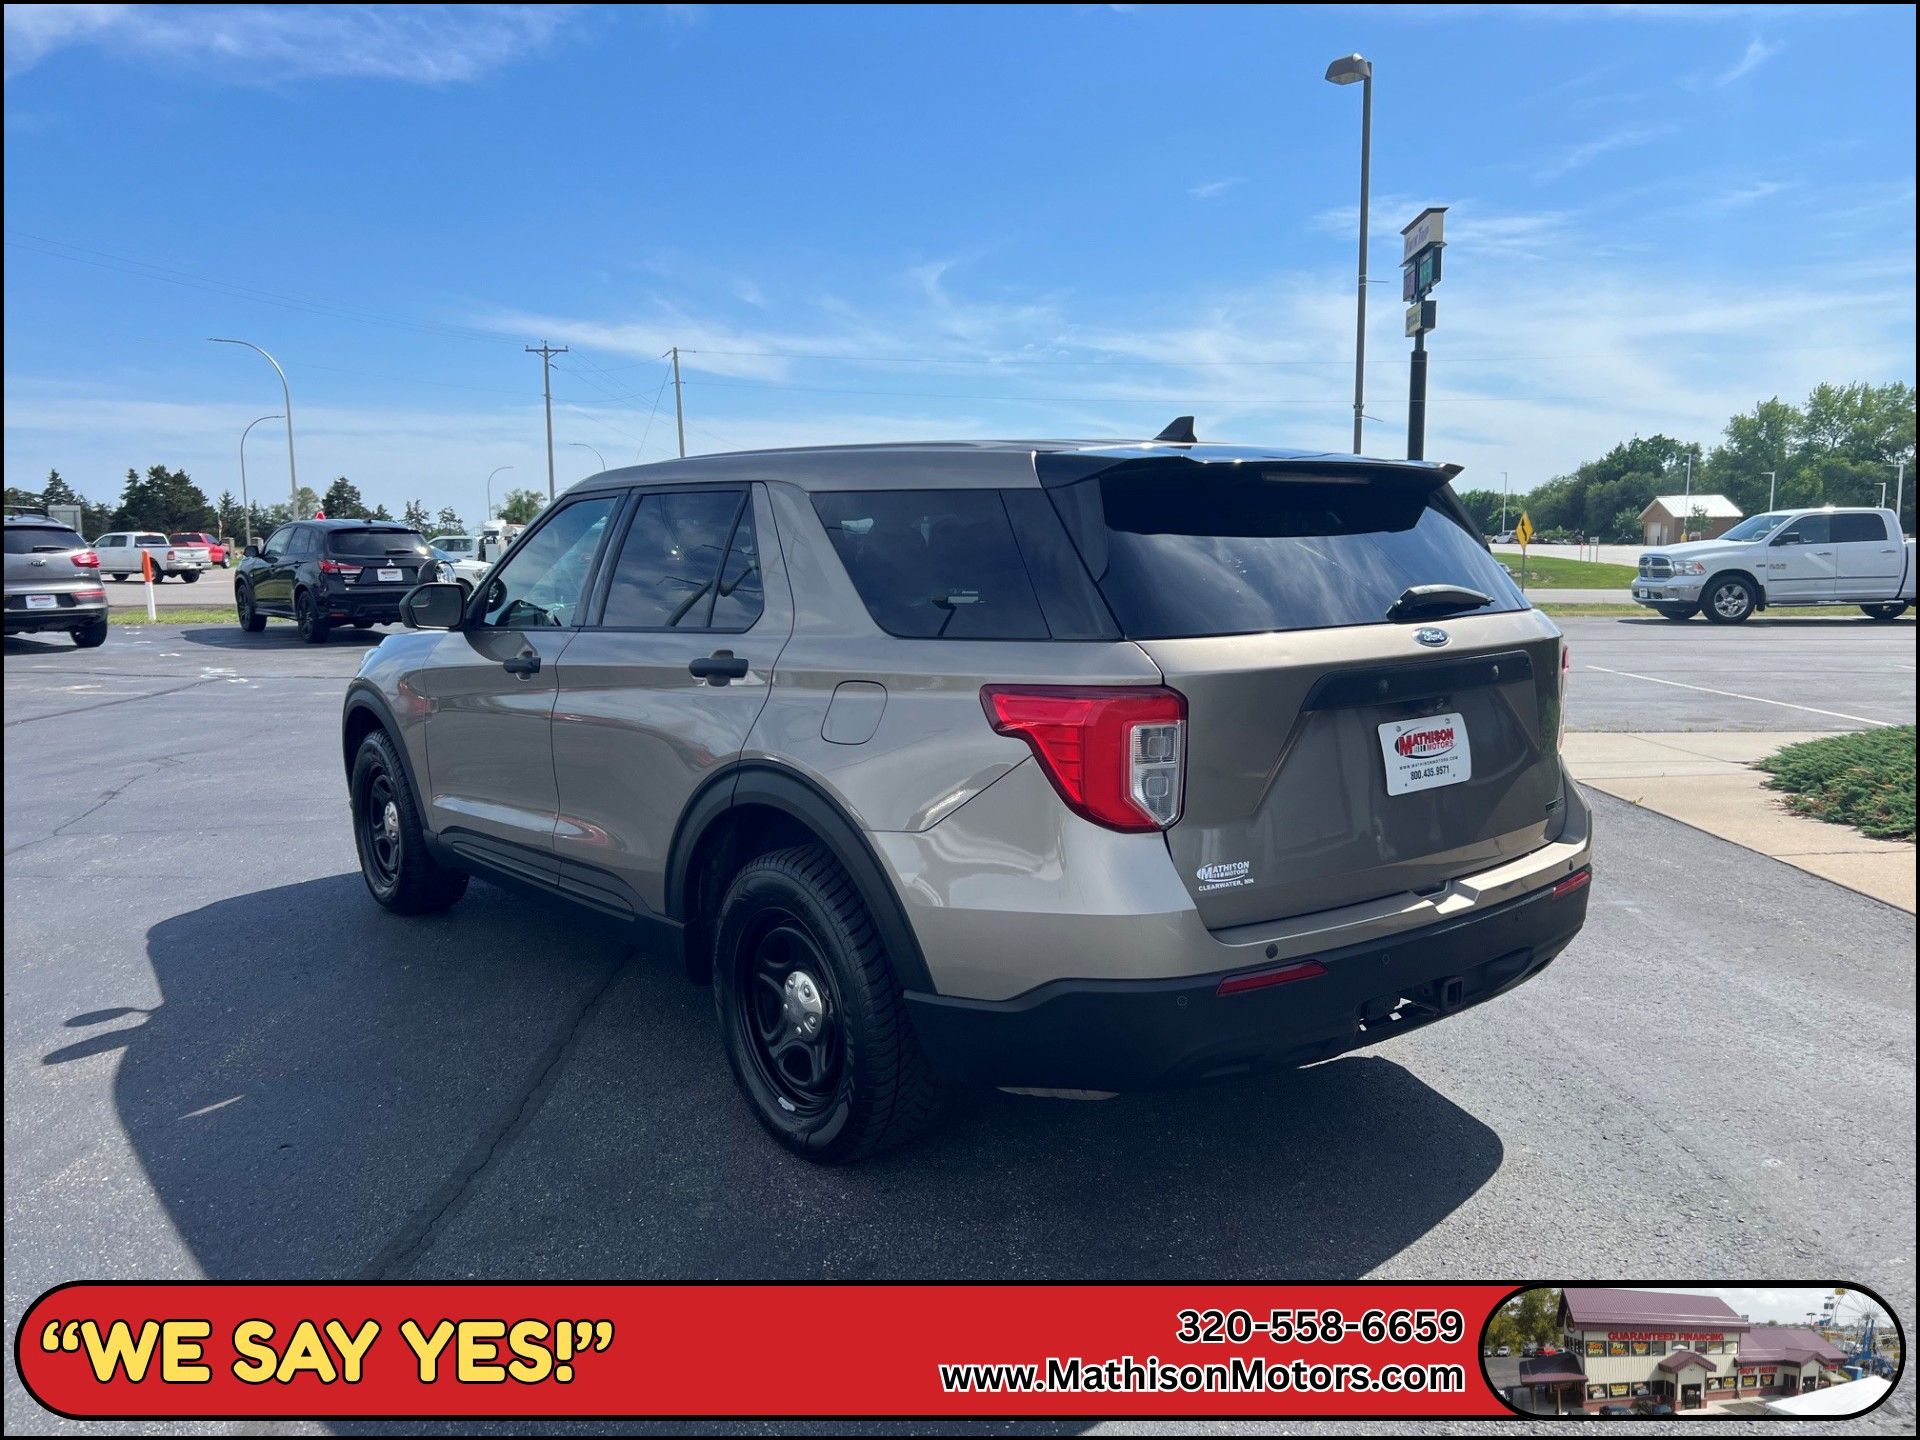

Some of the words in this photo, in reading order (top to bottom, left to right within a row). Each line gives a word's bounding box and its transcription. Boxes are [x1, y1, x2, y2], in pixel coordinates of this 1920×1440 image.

[1422, 630, 1445, 641] Ford
[1399, 728, 1454, 756] MATHISON
[1427, 740, 1454, 751] MOTORS
[1410, 764, 1450, 781] 800.435.9571
[1201, 861, 1250, 880] MATHISON
[1225, 868, 1249, 877] MOTORS
[1198, 881, 1244, 891] CLEARWATER,
